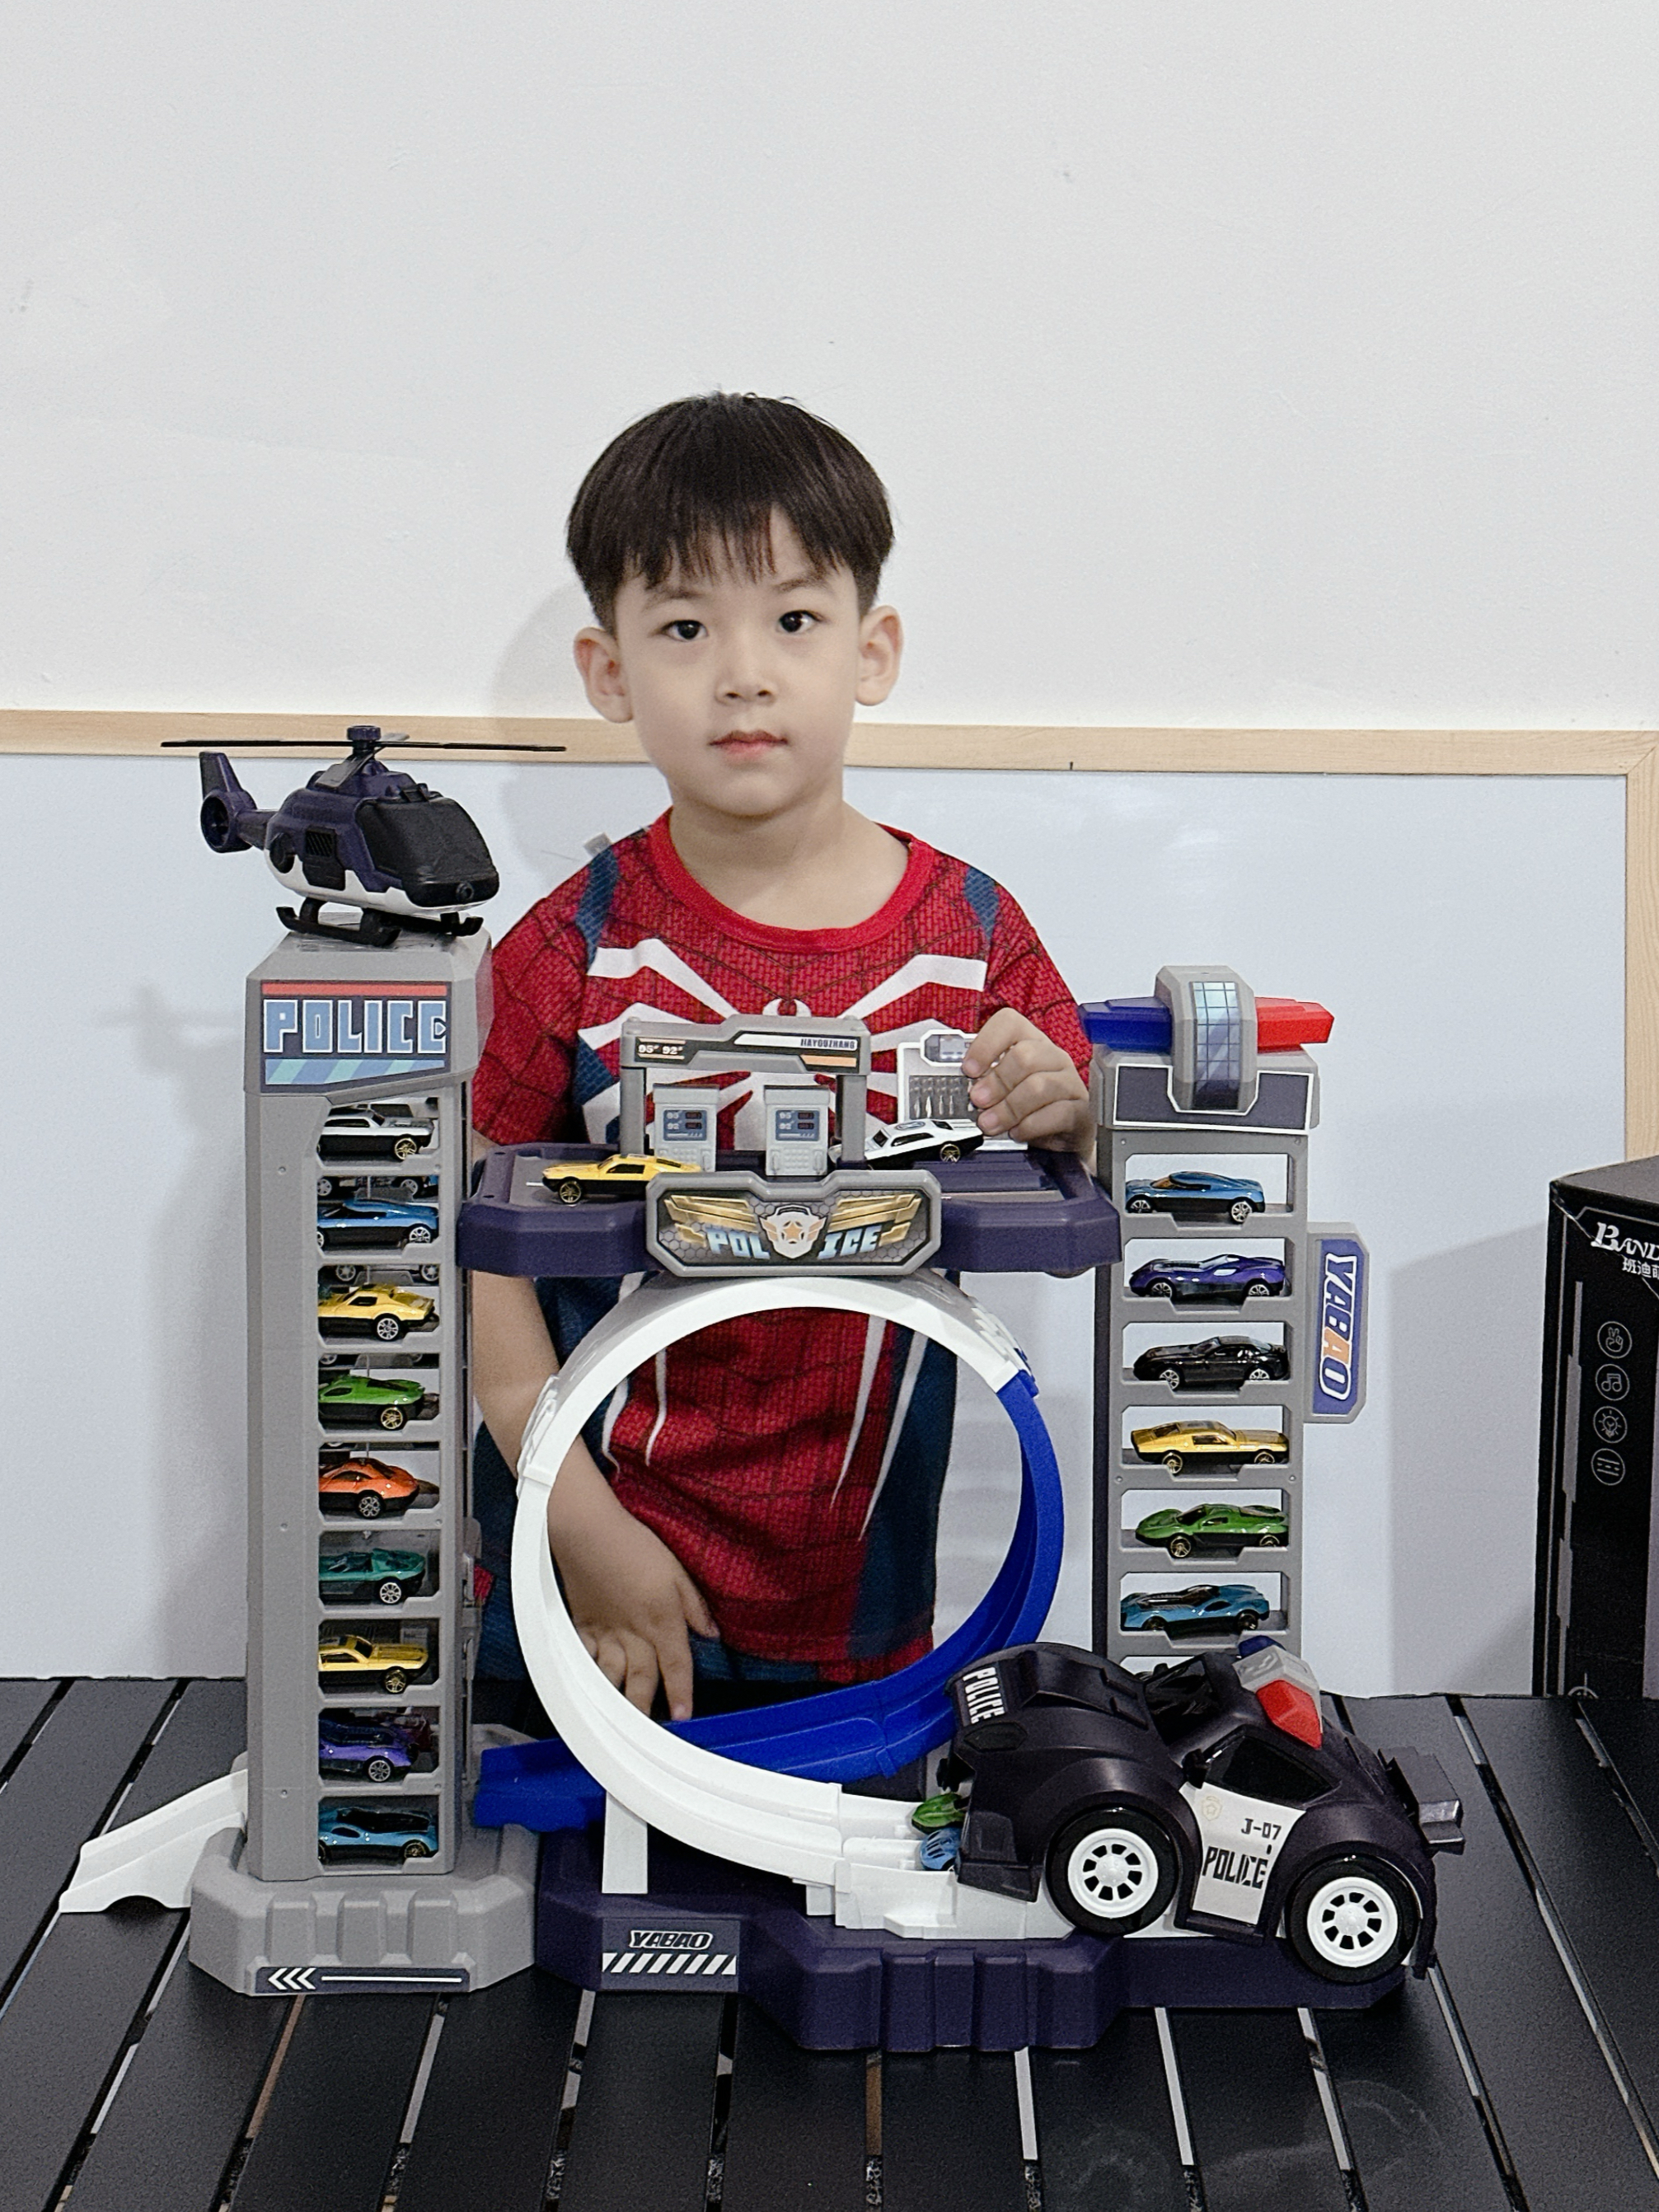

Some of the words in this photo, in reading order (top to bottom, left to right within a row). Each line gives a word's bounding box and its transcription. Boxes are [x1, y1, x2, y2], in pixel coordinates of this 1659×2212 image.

[263, 999, 447, 1054] POLICE
[1318, 1252, 1358, 1401] YABAO
[962, 1666, 1005, 1724] POLICE
[1240, 1817, 1282, 1840] J-07
[1202, 1845, 1269, 1890] POLICE
[629, 1929, 714, 1951] YABAO
